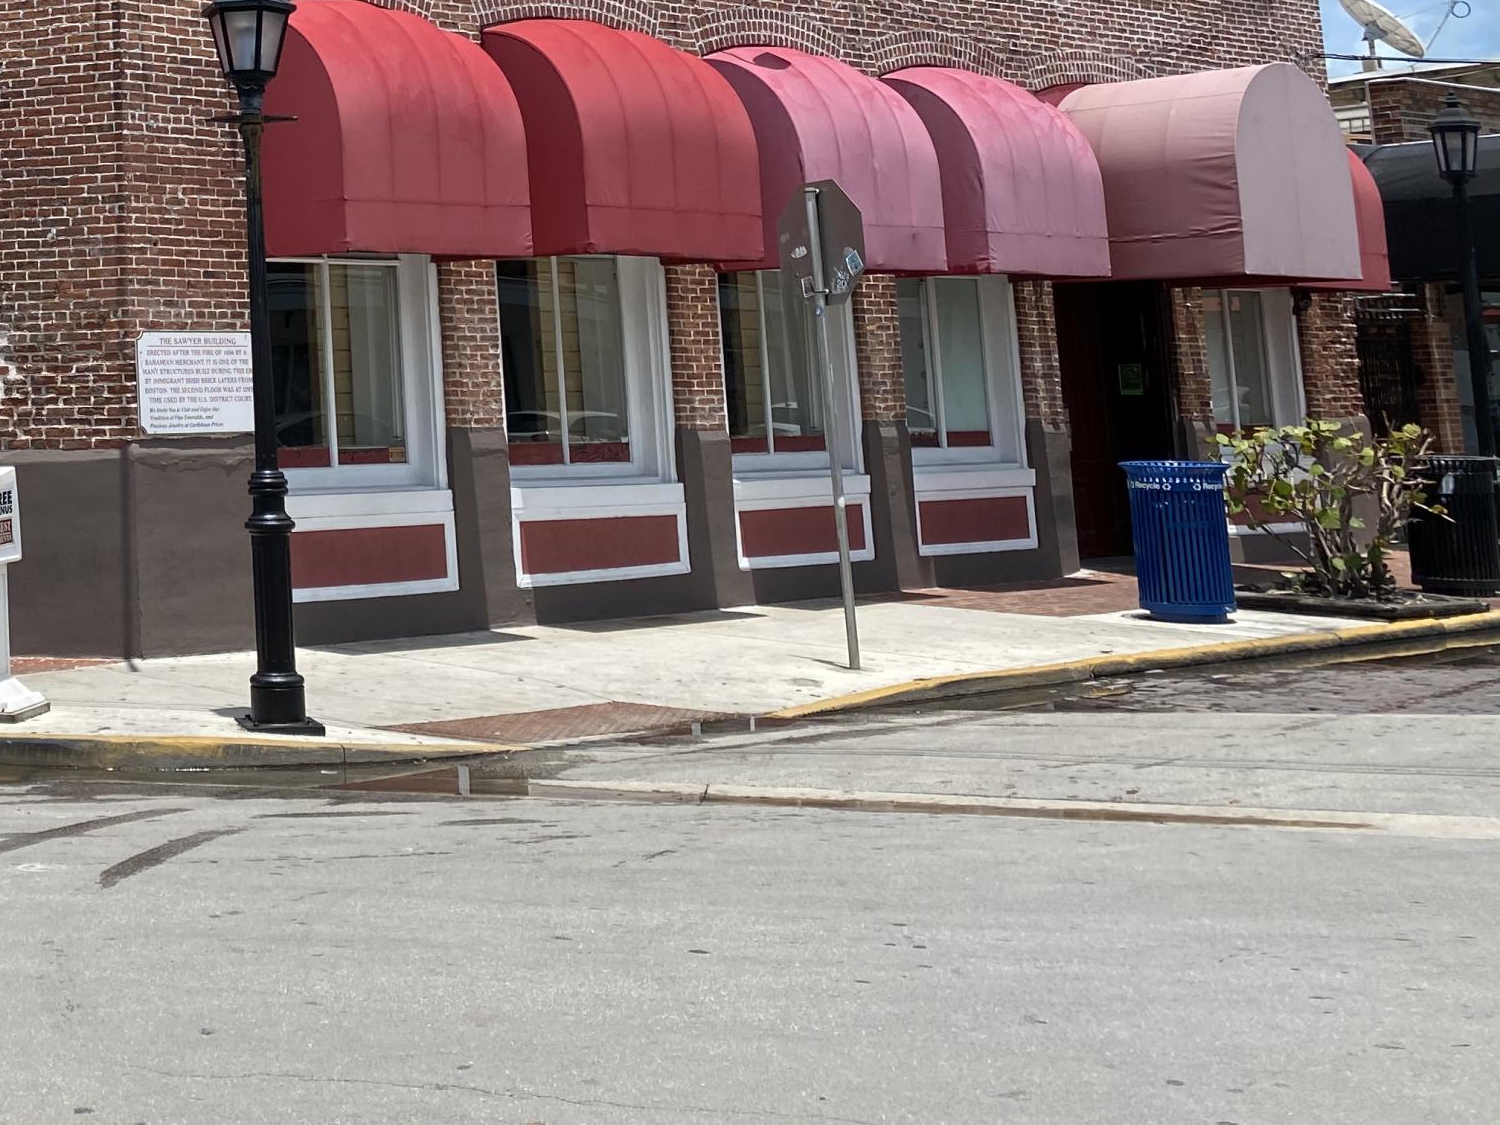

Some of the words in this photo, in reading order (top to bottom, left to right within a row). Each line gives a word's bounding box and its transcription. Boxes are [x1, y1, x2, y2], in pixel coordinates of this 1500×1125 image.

[160, 337, 172, 345] THE
[173, 337, 201, 345] SAWYER
[204, 337, 236, 345] BUILDING
[1135, 482, 1161, 490] Recycle
